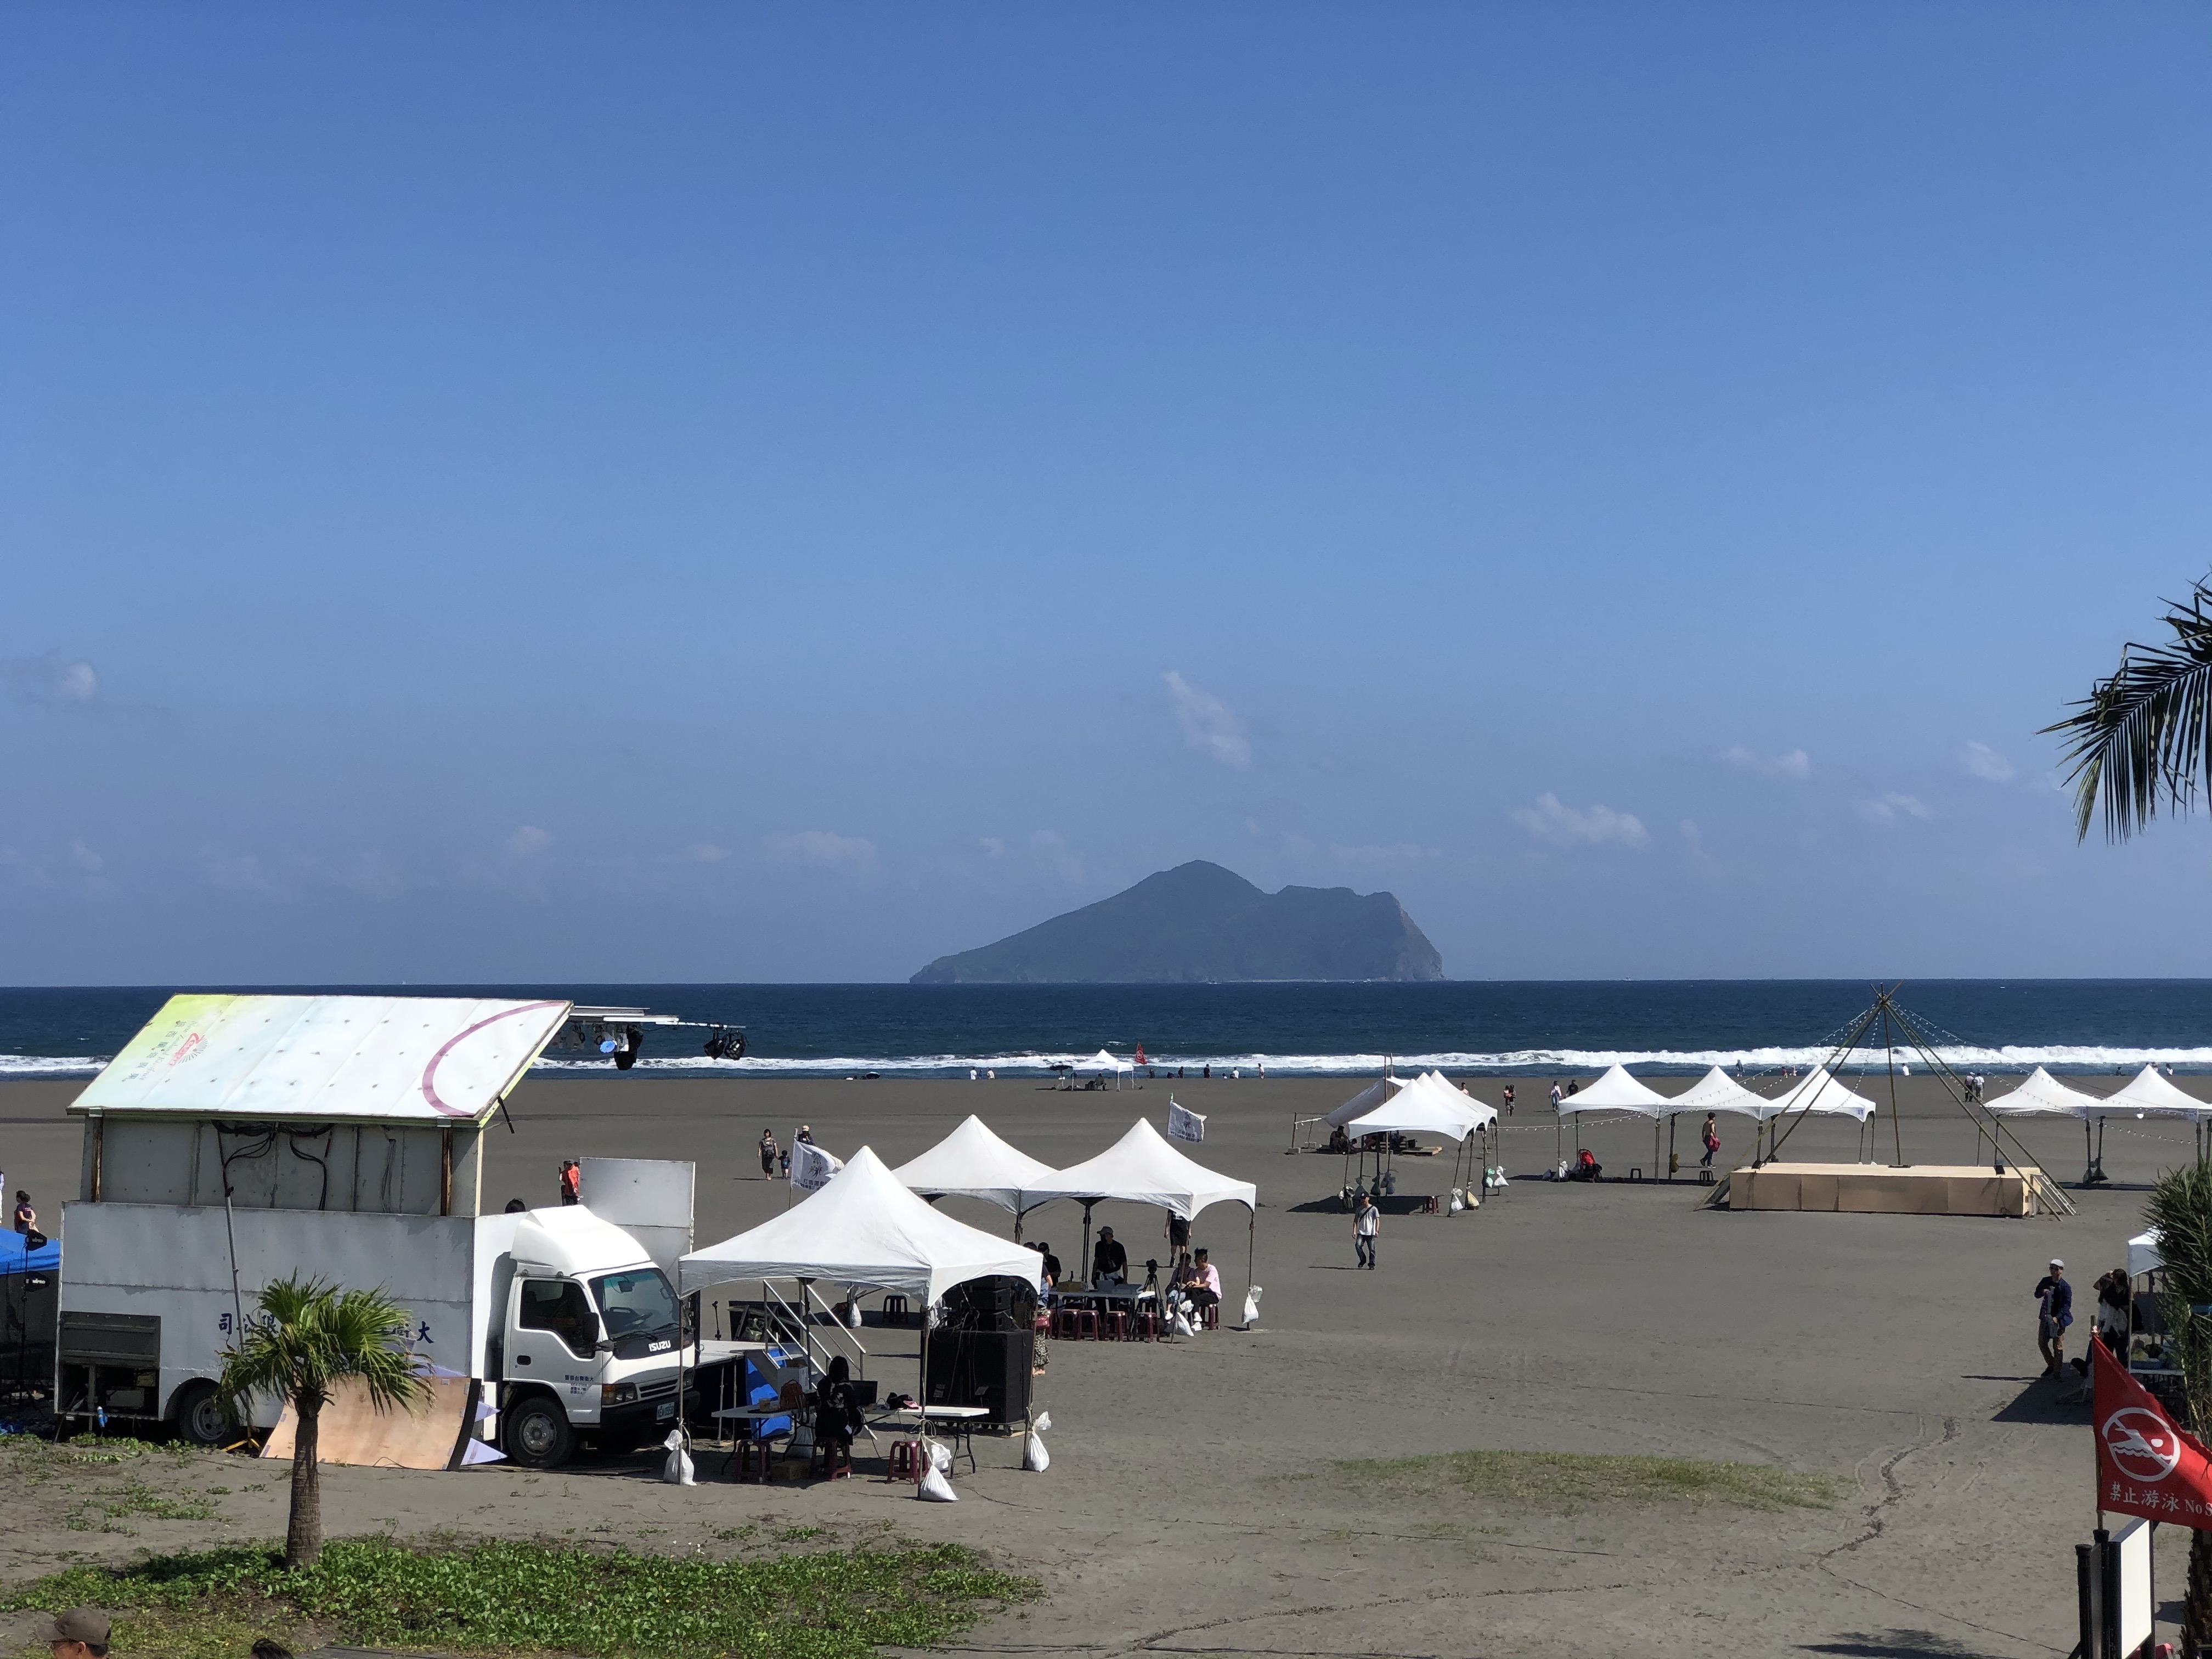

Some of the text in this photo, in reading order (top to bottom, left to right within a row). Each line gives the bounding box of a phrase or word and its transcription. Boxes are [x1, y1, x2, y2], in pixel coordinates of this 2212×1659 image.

[648, 1340, 671, 1352] ISUZU
[2110, 1481, 2181, 1513] 禁止游泳
[2184, 1499, 2203, 1514] No
